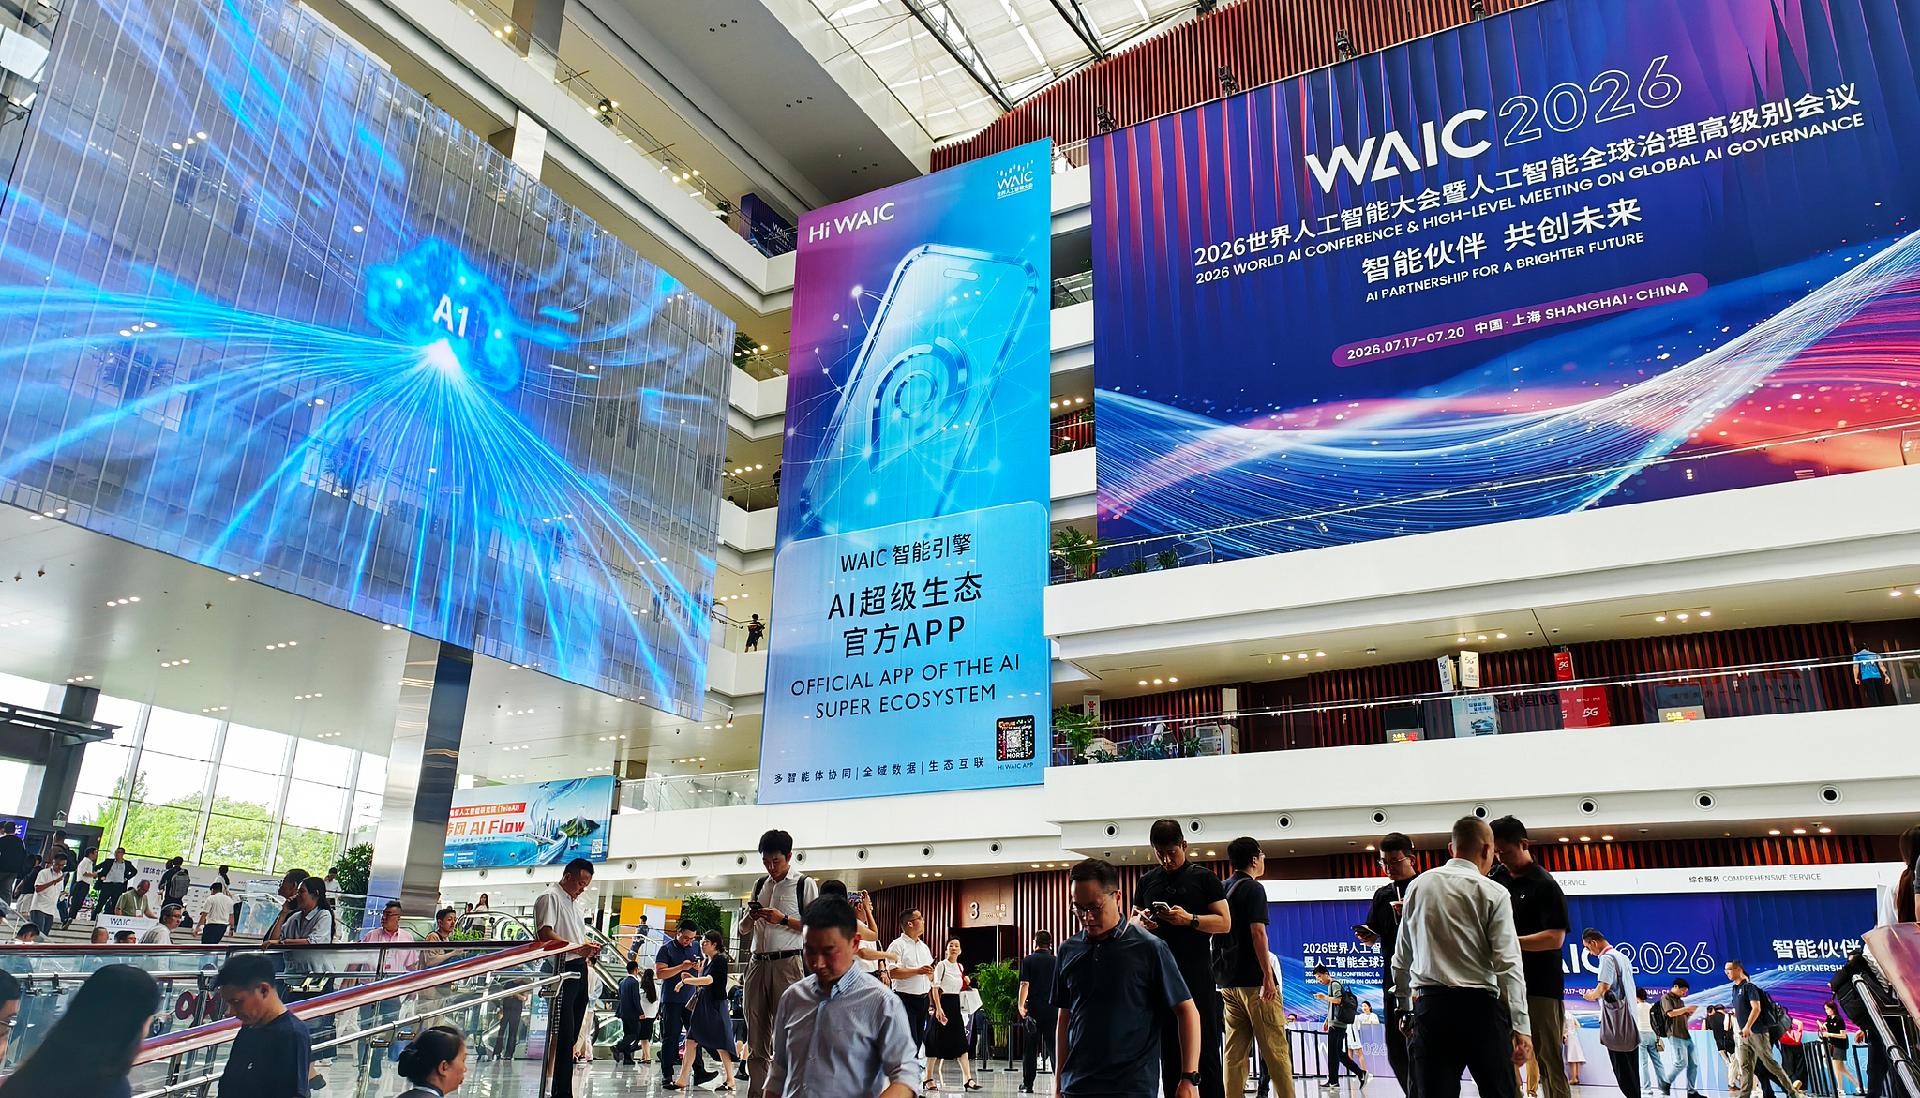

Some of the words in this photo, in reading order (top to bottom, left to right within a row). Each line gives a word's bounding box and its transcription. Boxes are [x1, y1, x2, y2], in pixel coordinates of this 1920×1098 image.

[1304, 108, 1492, 194] WAIC
[1498, 55, 1682, 147] 2026
[997, 171, 1034, 190] WAIC
[1194, 82, 1861, 266] 2026世界人工智能大会暨人工智能全球治理高级别会议
[1195, 266, 1230, 284] 2026
[1233, 253, 1284, 276] WORLD
[1287, 247, 1302, 263] AI
[1304, 223, 1403, 257] CONFERENCE
[1406, 220, 1419, 234] &
[1423, 197, 1516, 230] HIGH-LEVEL
[1519, 178, 1593, 206] MEETING
[1597, 170, 1625, 187] ON
[1628, 153, 1701, 179] GLOBAL
[1704, 146, 1722, 162] AI
[1726, 112, 1865, 156] GOVERNANCE
[808, 221, 831, 244] Hi
[833, 202, 895, 235] WAIC
[1361, 232, 1487, 284] 智能伙伴
[1503, 197, 1643, 252] 共创未来
[1366, 291, 1379, 303] AI
[1381, 270, 1469, 300] PARTNERSHIP
[1472, 263, 1499, 279] FOR
[1503, 262, 1514, 273] A
[1516, 244, 1585, 270] BRIGHTER
[1588, 231, 1645, 253] FUTURE
[1346, 325, 1465, 361] 2026.07.17-07.20
[840, 548, 888, 573] WAIC
[892, 533, 972, 566] 智能引擎
[828, 570, 983, 620] AI超级生态
[843, 615, 966, 659] 官方APP
[790, 671, 874, 697] OFFICIAL
[878, 667, 914, 687] APP
[922, 662, 949, 681] OF
[953, 656, 993, 677] THE
[998, 653, 1019, 673] AI
[816, 698, 872, 719] SUPER
[879, 683, 996, 714] ECOSYSTEM
[470, 820, 486, 836] AI
[488, 818, 526, 835] Flow
[1559, 878, 1587, 887] SERVICE
[1722, 874, 1787, 883] COMPREHENSIVE
[1789, 873, 1823, 881] SERVICE
[110, 917, 131, 926] WAIC
[970, 901, 980, 919] 3
[1777, 964, 1787, 972] AI
